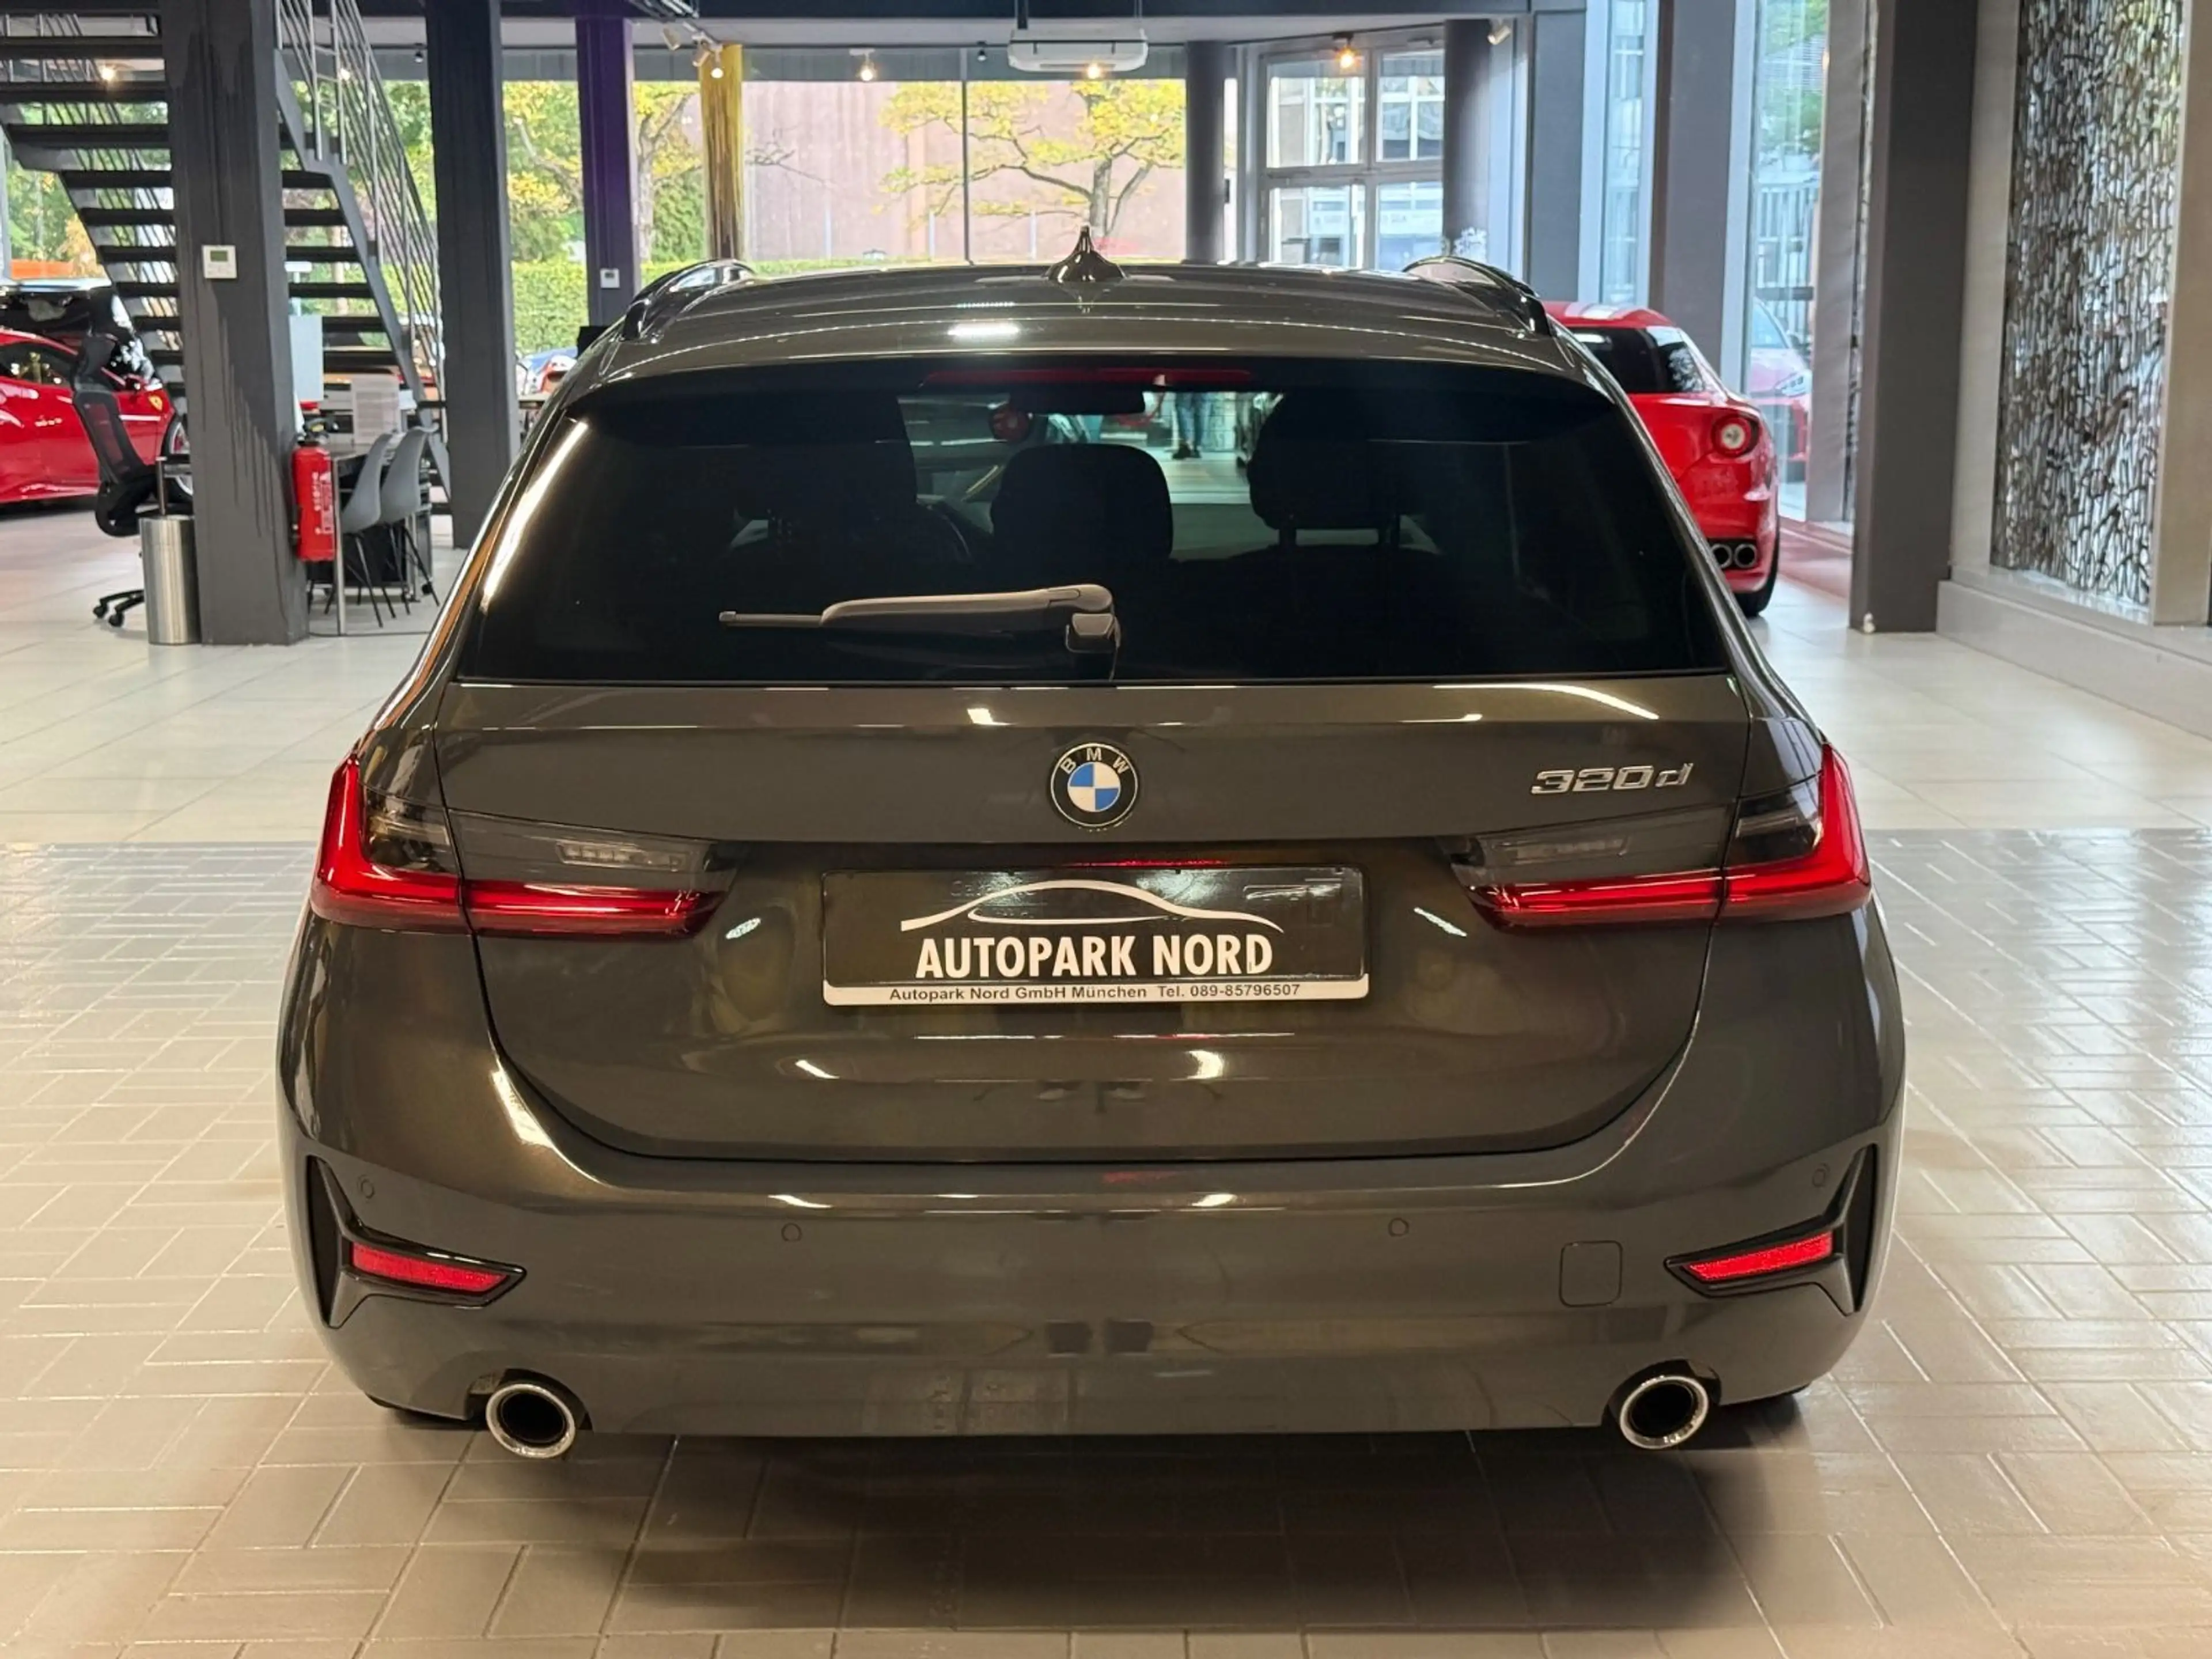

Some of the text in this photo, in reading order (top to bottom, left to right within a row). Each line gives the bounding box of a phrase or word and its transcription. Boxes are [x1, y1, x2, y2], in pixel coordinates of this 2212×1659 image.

[1060, 747, 1130, 775] BMW
[1531, 762, 1694, 794] 320d
[915, 933, 1273, 979] AUTOPARK NORD
[889, 984, 1301, 1002] Autopark Nord GmbH München Tel. 089-85796507
